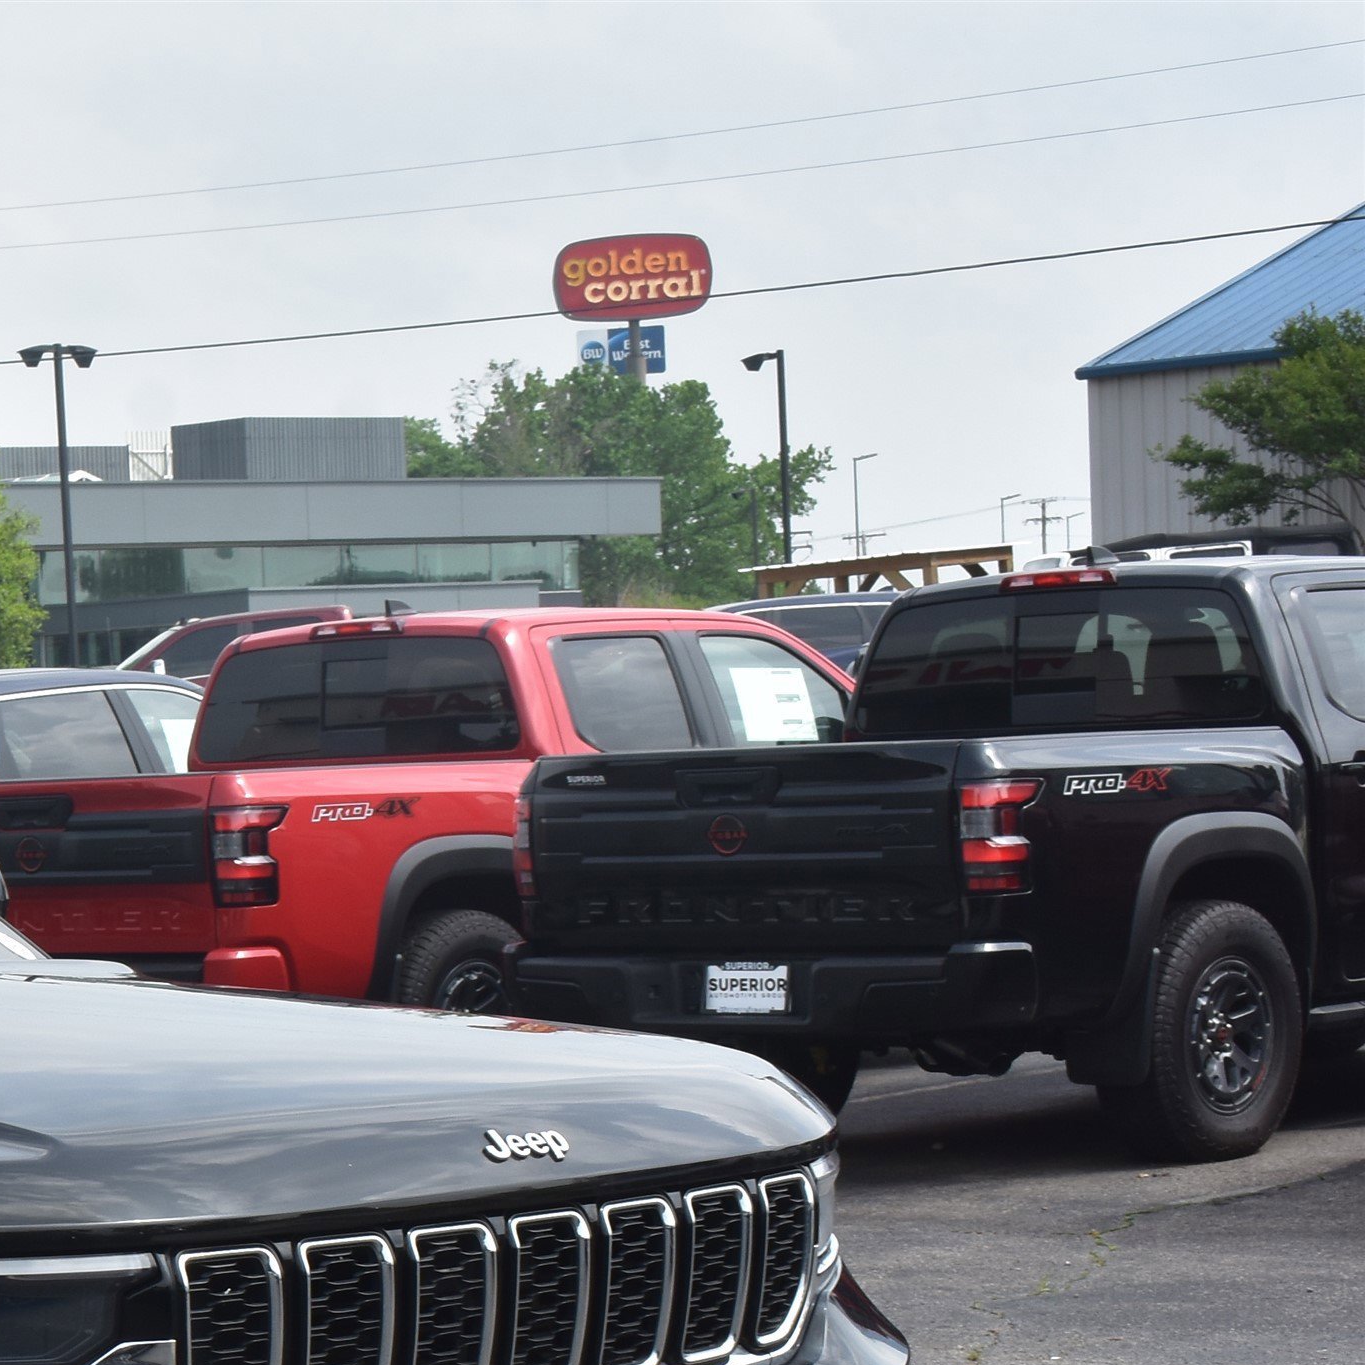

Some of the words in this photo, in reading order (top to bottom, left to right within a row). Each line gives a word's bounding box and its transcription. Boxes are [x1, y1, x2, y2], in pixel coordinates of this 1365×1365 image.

[563, 249, 690, 287] golden
[584, 270, 703, 303] corral
[623, 339, 651, 350] Bst
[724, 961, 771, 971] SUPERIOR
[709, 977, 788, 992] SUPERIOR
[483, 1129, 570, 1162] Jeep
